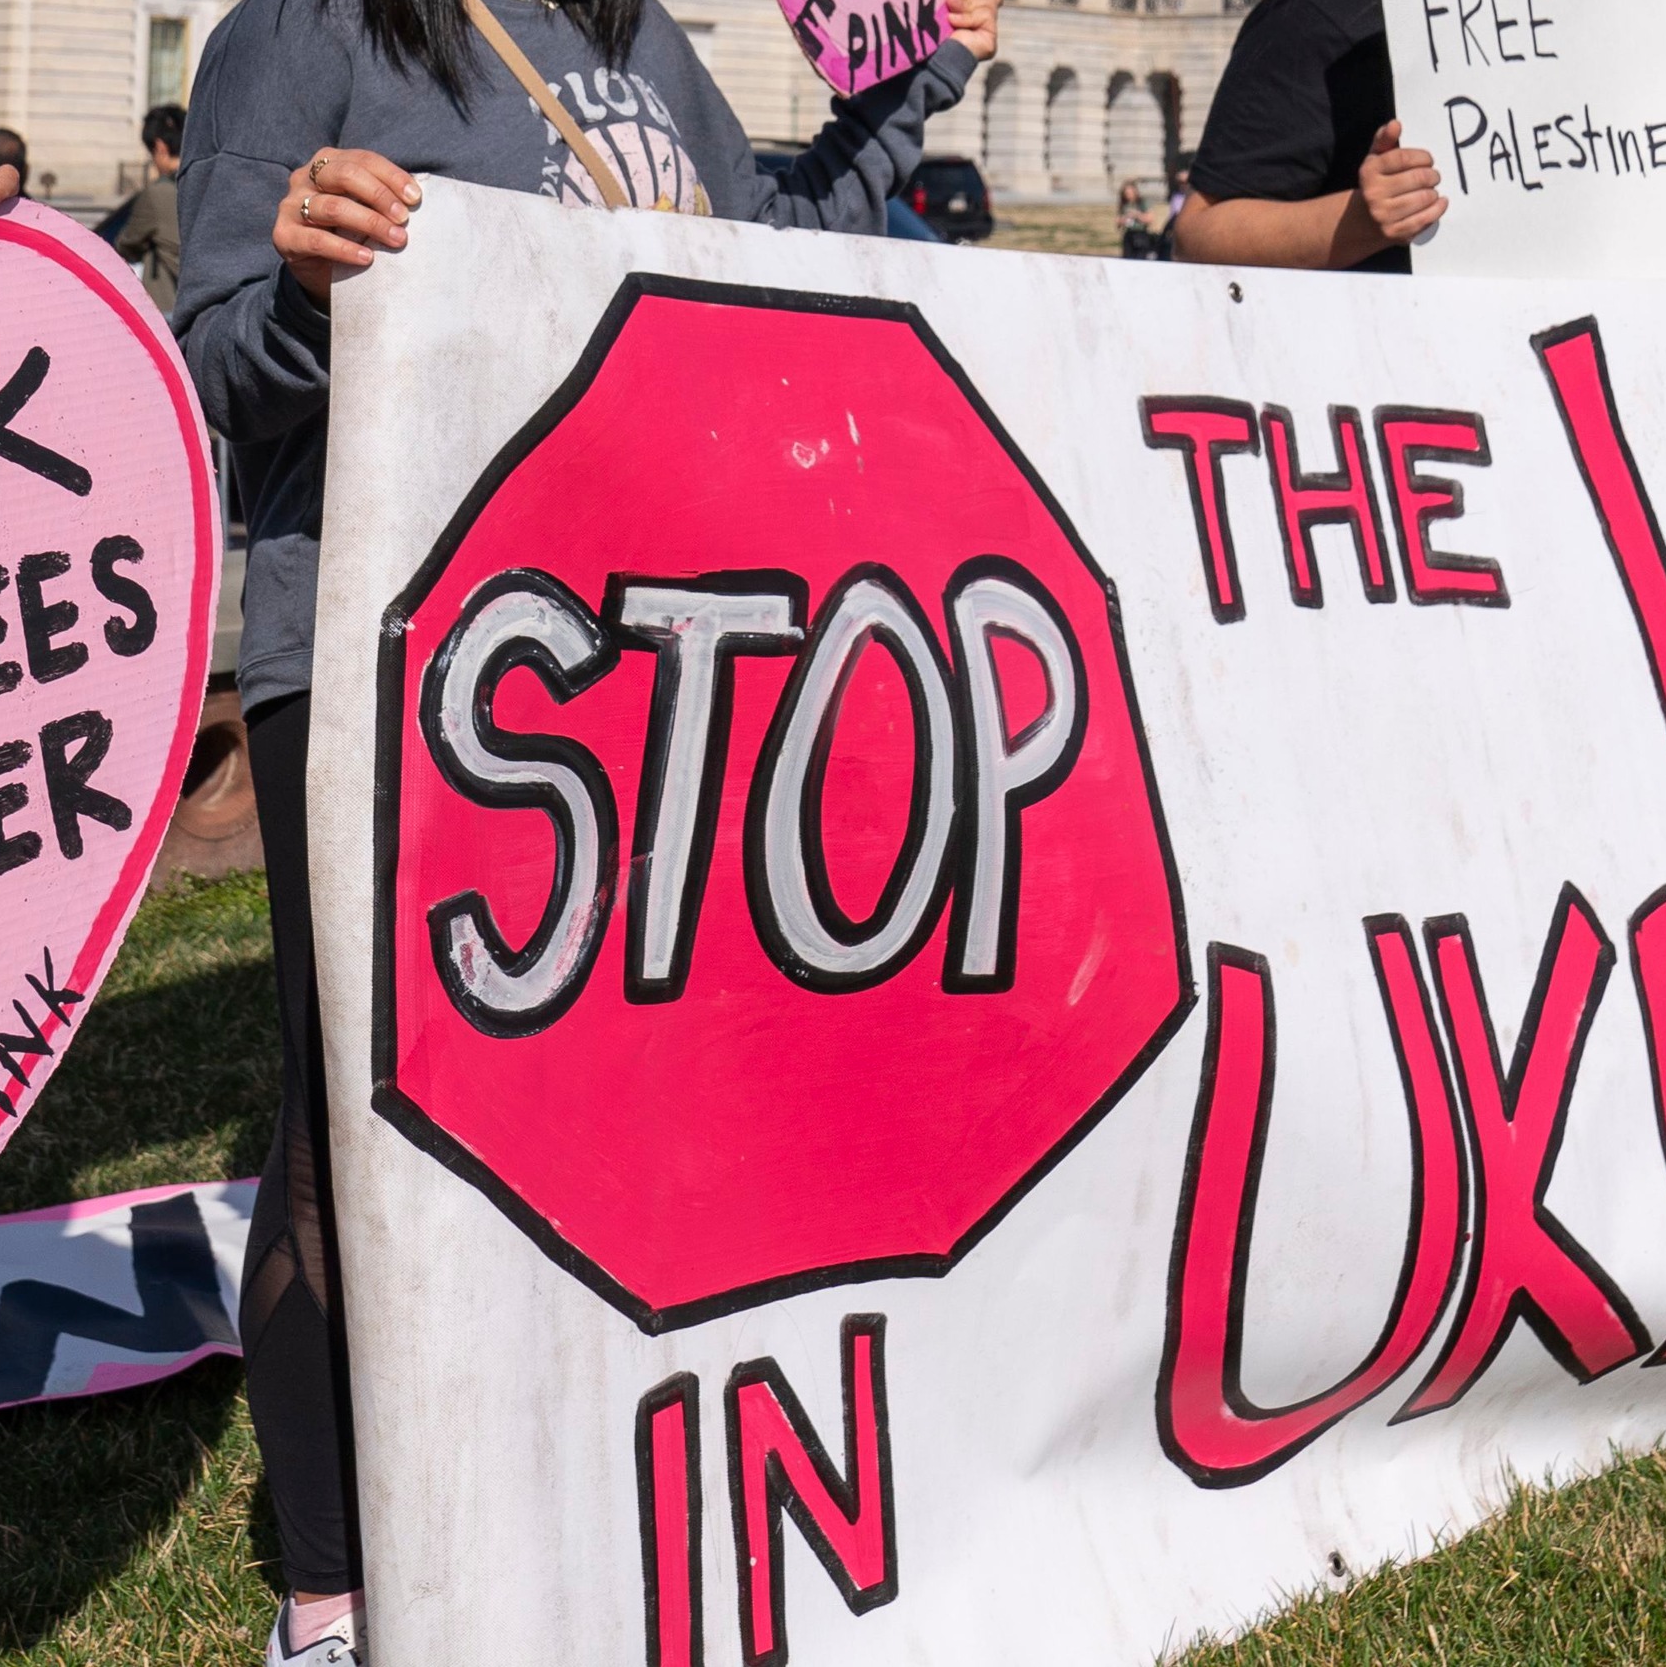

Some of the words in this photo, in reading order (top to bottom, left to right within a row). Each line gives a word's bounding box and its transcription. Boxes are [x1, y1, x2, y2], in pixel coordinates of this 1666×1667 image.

[424, 553, 1086, 1038] STOP
[1140, 393, 1511, 624] THE
[634, 1312, 899, 1667] IN
